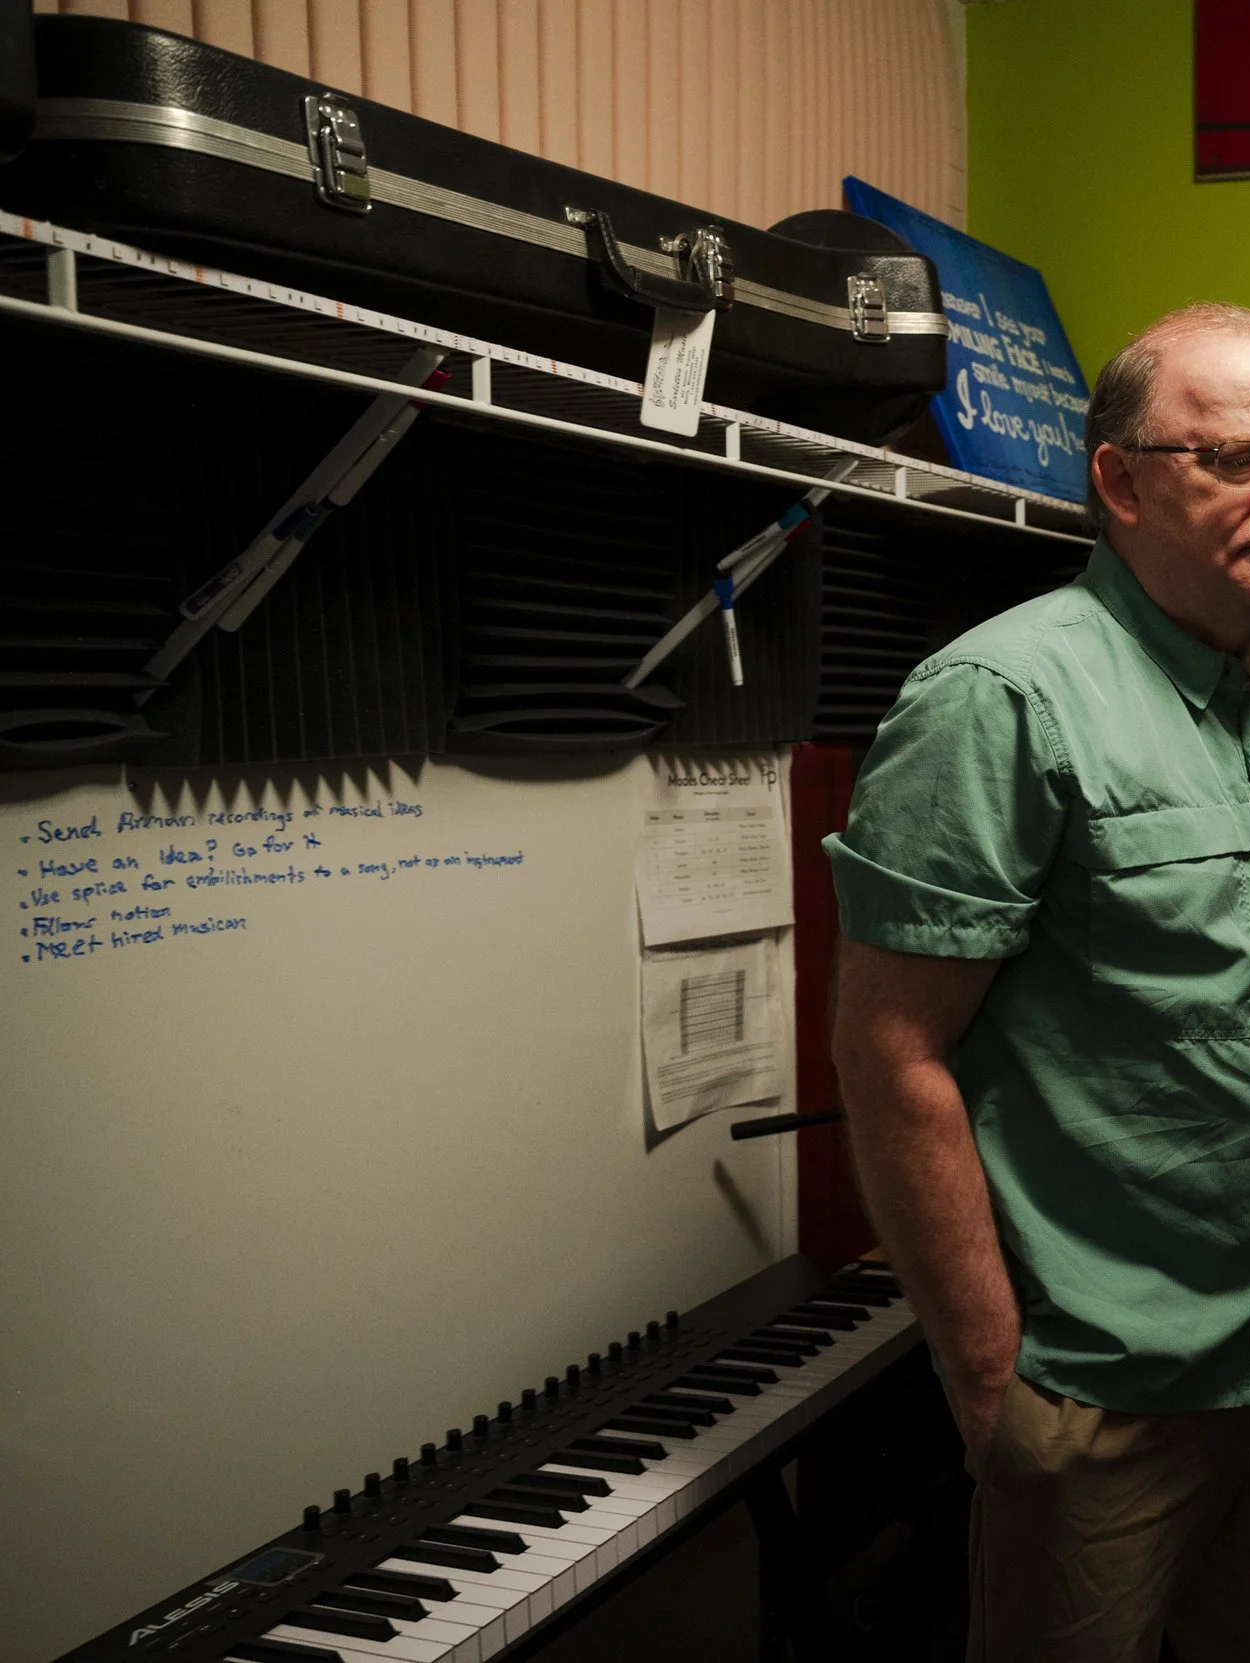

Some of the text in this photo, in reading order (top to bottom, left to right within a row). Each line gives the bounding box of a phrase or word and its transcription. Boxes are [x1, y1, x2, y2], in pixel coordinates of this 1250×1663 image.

[946, 319, 1004, 362] MILING
[1001, 334, 1044, 377] FACE
[956, 368, 978, 430] I
[981, 389, 1030, 441] love
[699, 772, 727, 787] Cheat
[728, 771, 751, 787] Sheet
[37, 814, 103, 844] Send
[208, 807, 294, 832] recordings
[328, 800, 384, 818] musical
[30, 886, 60, 907] Use
[140, 873, 176, 891] for
[313, 864, 334, 879] to
[340, 867, 352, 877] a
[398, 855, 422, 870] not
[39, 857, 99, 880] Have
[111, 856, 141, 872] an
[232, 842, 257, 858] Go
[262, 834, 295, 854] for
[36, 934, 104, 961] Meet
[128, 1580, 240, 1648] ALESIS
